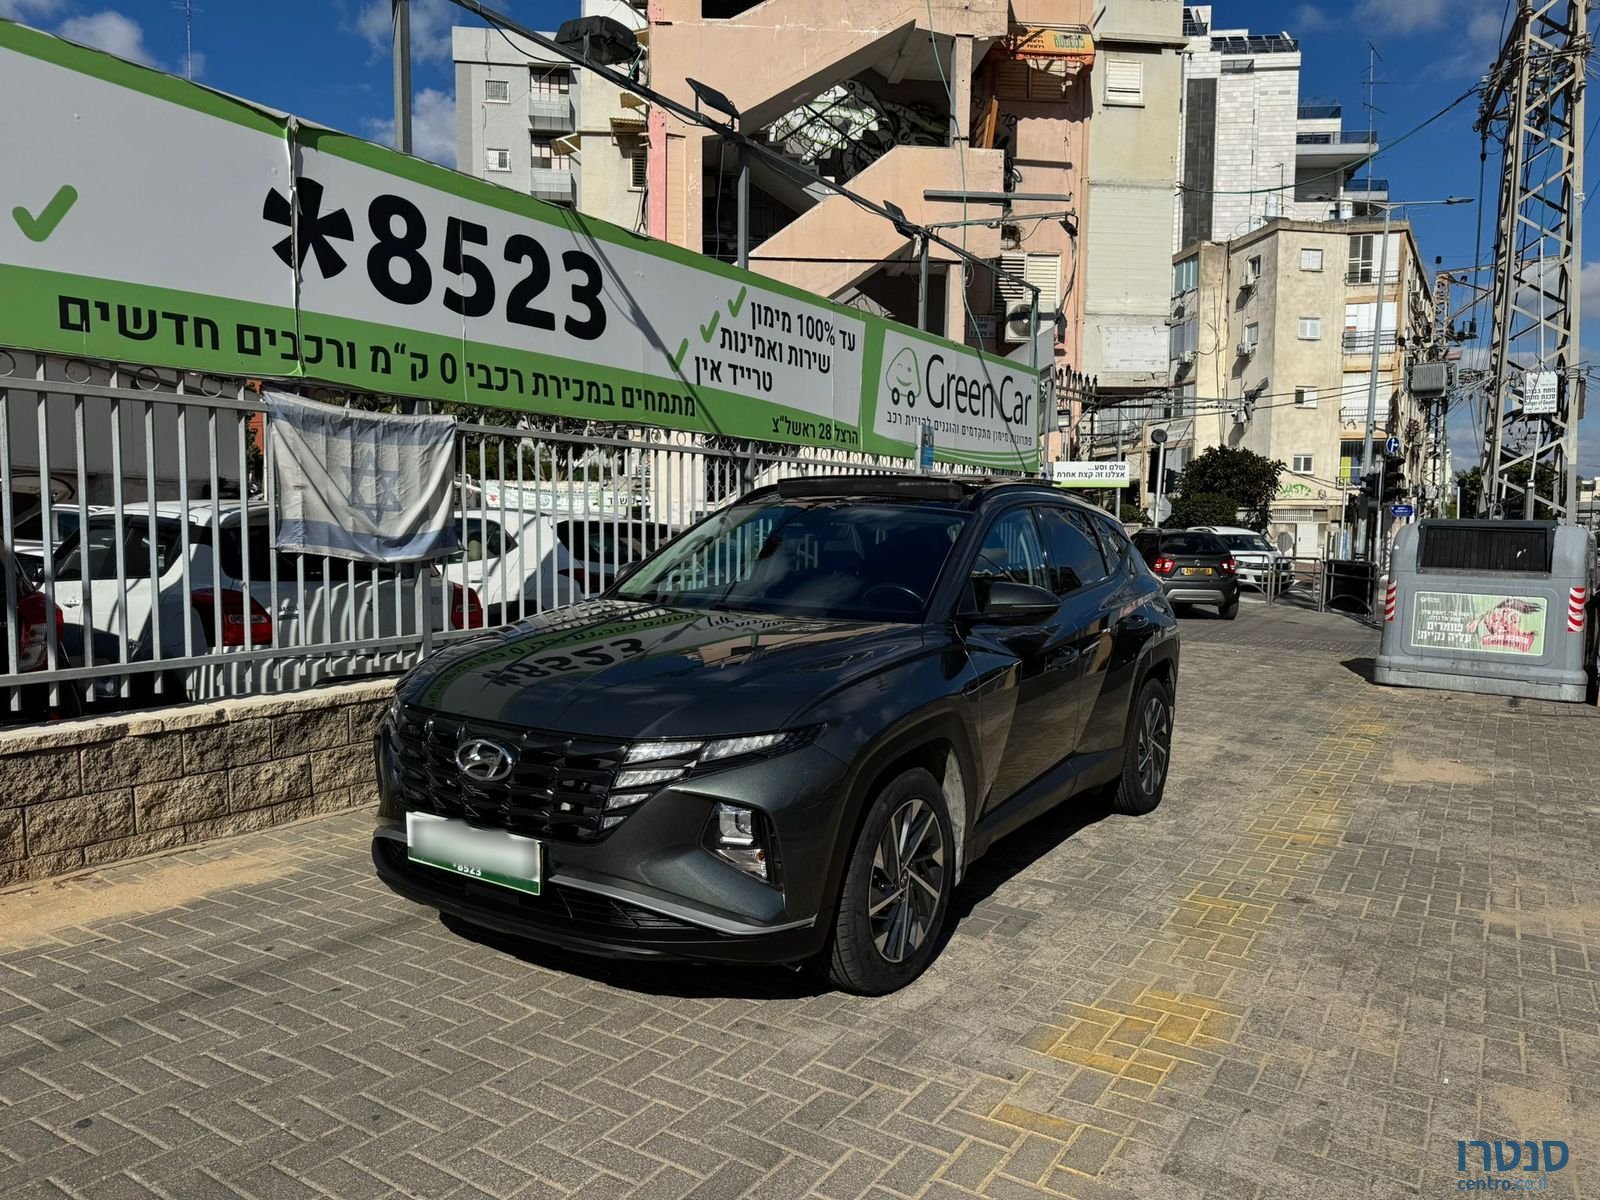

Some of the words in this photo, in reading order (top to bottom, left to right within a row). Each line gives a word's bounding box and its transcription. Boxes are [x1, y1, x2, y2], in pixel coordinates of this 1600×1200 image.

[58, 295, 220, 350] חדשים
[751, 302, 792, 333] מימון
[797, 314, 835, 346] 100%
[236, 323, 357, 369] ורכבים
[720, 327, 783, 363] ואמינות
[839, 330, 856, 351] עד
[440, 352, 457, 384] 0
[695, 356, 722, 385] אין
[788, 345, 830, 374] שירות
[466, 362, 523, 394] רכבי
[532, 372, 615, 406] במכירת
[728, 363, 773, 392] טרייד
[621, 386, 696, 417] מתמחים
[819, 423, 832, 440] 28
[887, 411, 902, 424] רכב
[961, 425, 991, 440] מתקדמים
[834, 424, 858, 444] הרצל
[1109, 463, 1126, 471] שלם
